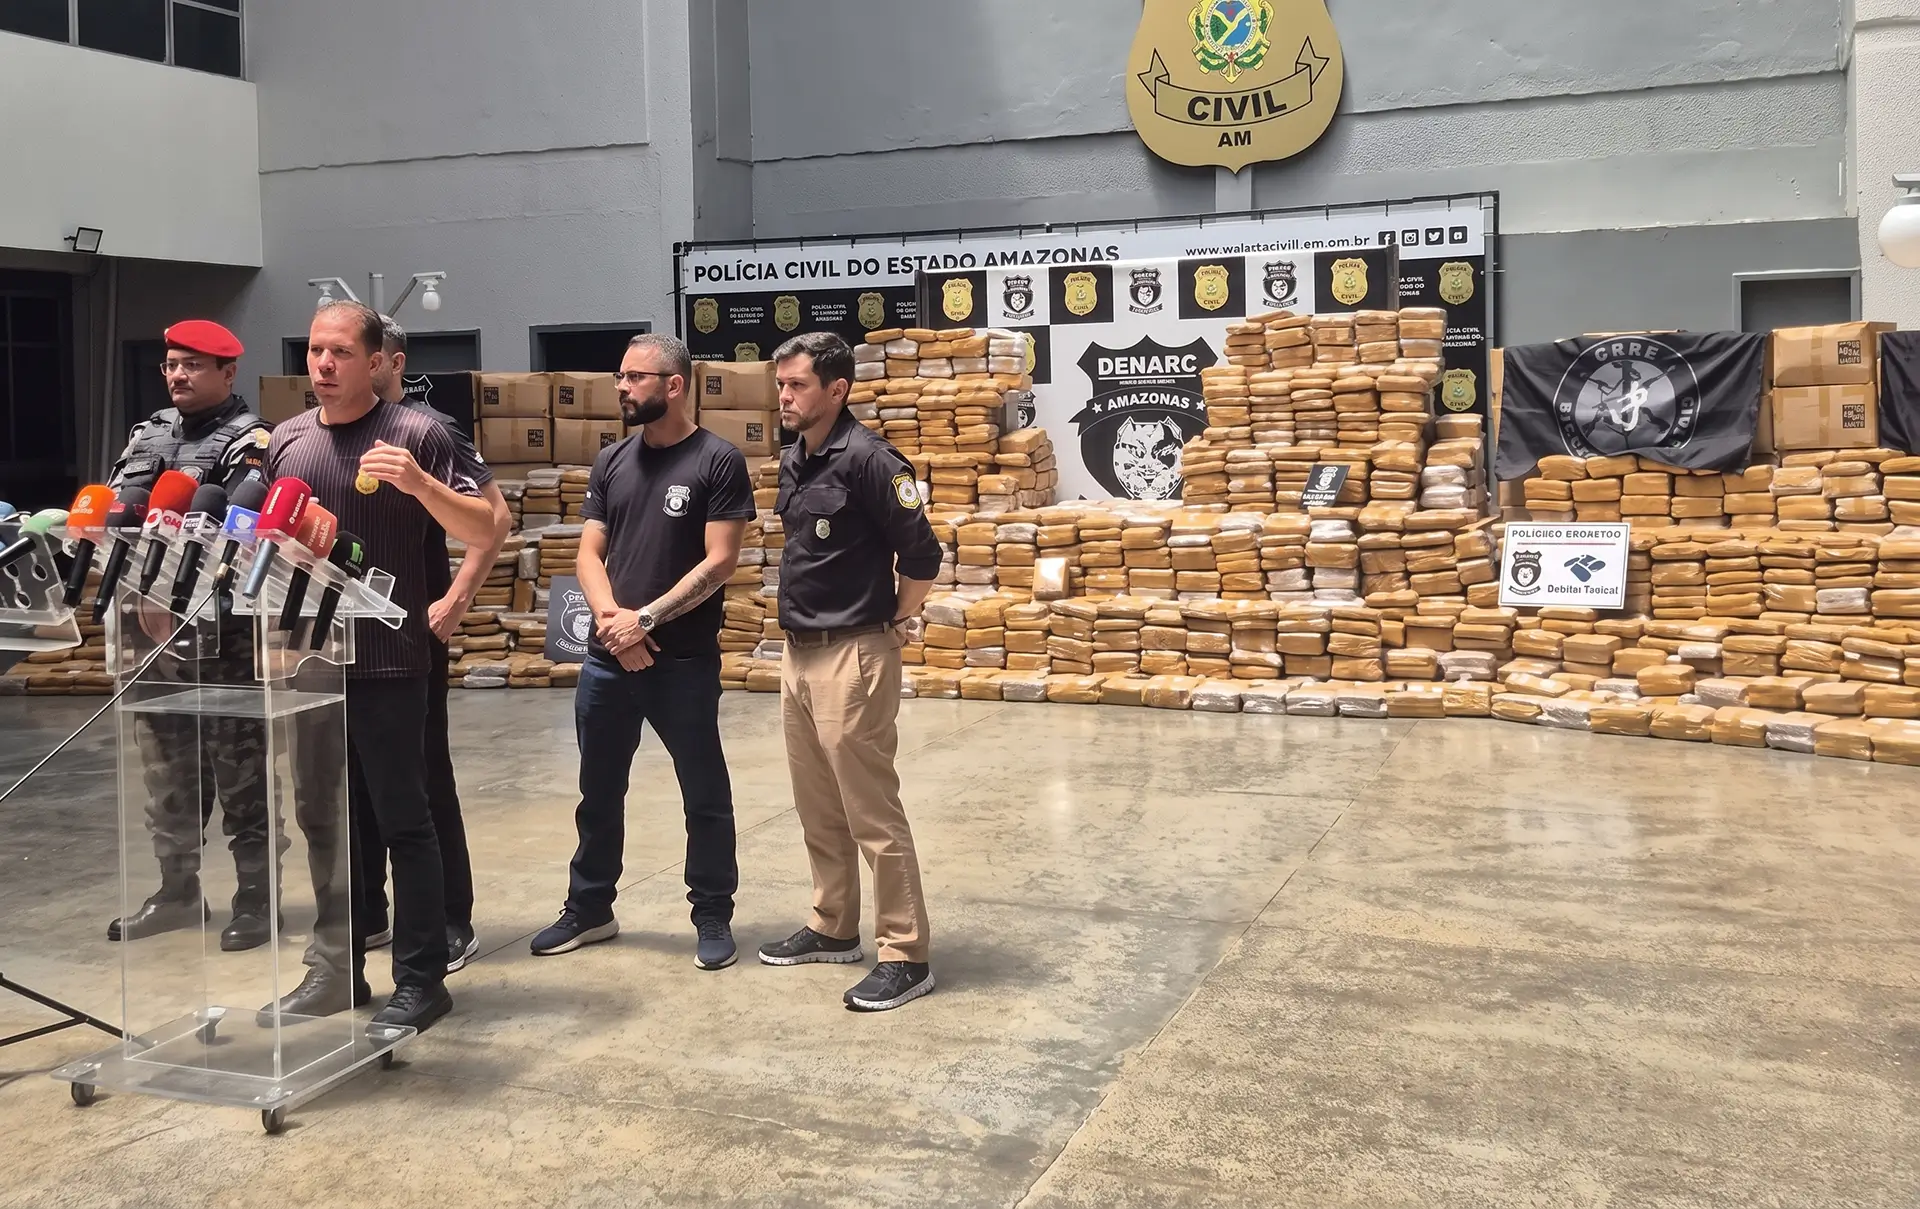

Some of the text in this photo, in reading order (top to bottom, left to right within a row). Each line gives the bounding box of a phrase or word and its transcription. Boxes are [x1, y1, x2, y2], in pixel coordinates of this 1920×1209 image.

[1187, 90, 1287, 121] CIVIL
[1217, 131, 1251, 147] AM
[694, 245, 1119, 282] POLÍCIA CIVIL DO ESTADO AMAZONAS
[1097, 354, 1197, 376] DENARC
[1107, 392, 1190, 411] AMAZONAS
